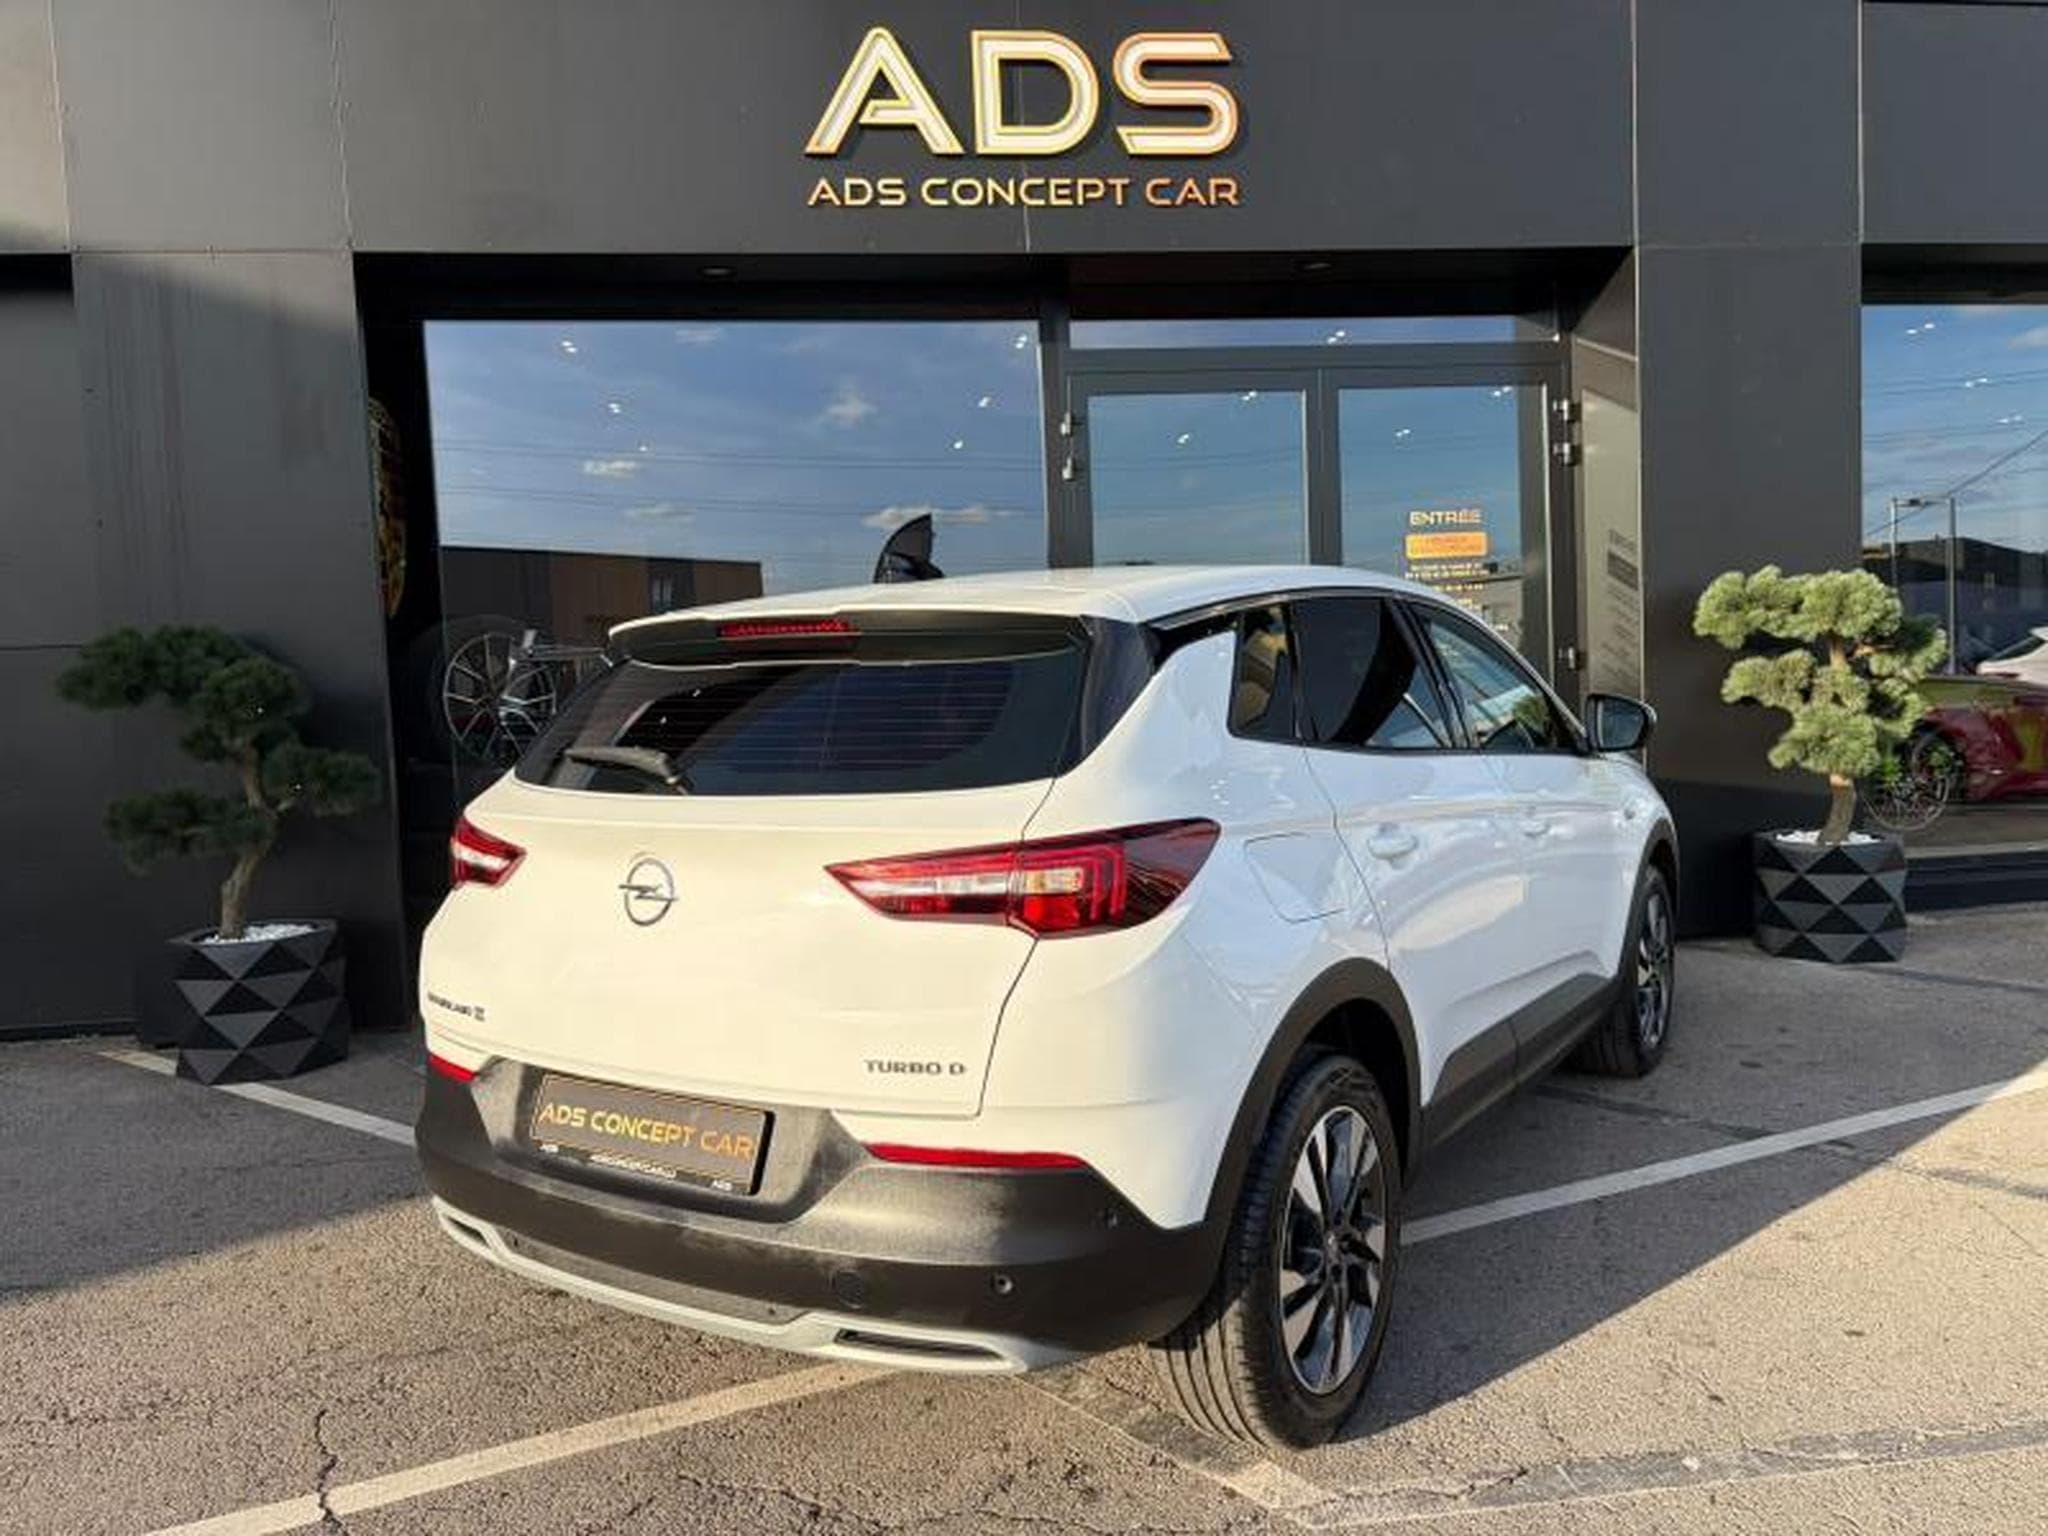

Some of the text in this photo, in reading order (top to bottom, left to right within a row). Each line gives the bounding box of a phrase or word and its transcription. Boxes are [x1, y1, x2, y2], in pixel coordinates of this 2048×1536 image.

[804, 26, 1239, 155] ADS
[808, 178, 1239, 206] ADS CONCEPT CAR
[864, 1059, 964, 1075] TURBO D
[539, 1103, 751, 1159] ADS CONCEPT CAR
